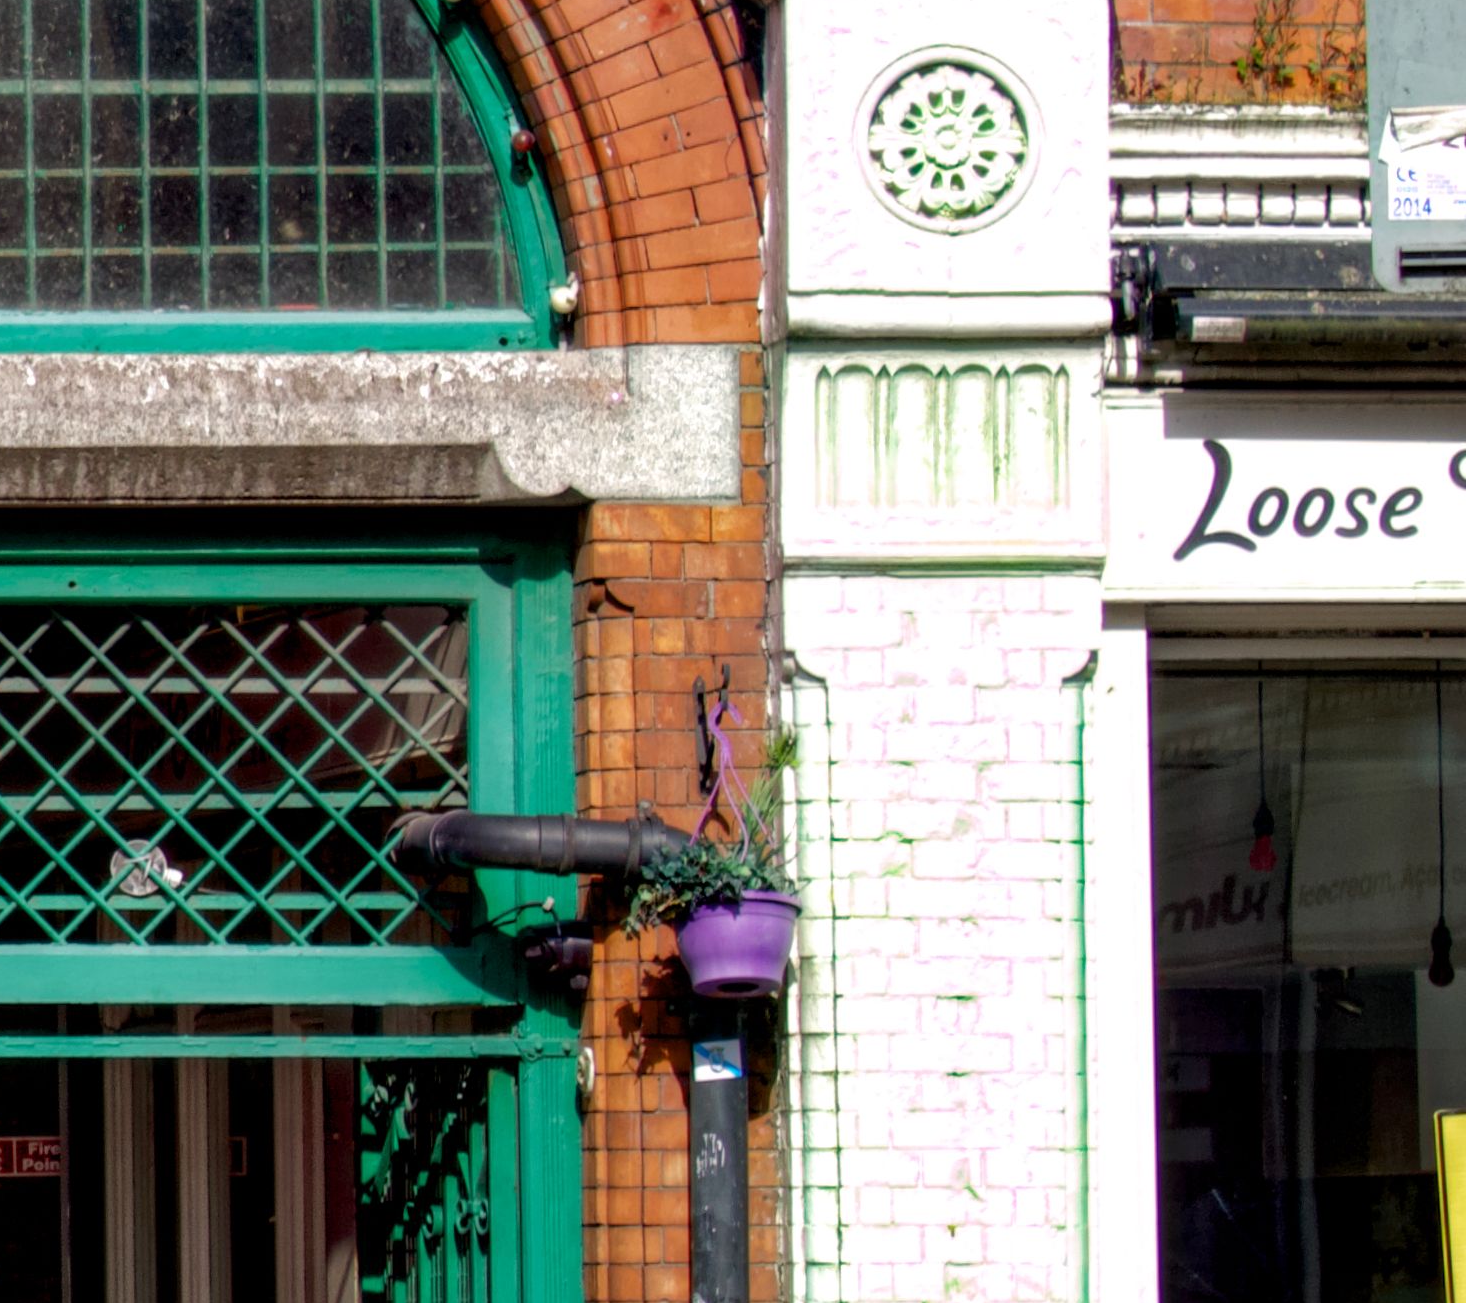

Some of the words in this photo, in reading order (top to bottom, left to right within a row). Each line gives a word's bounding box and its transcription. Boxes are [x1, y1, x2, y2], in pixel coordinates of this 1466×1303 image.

[1393, 197, 1432, 217] 2014
[1173, 439, 1423, 562] Loose
[28, 1142, 61, 1155] Fire
